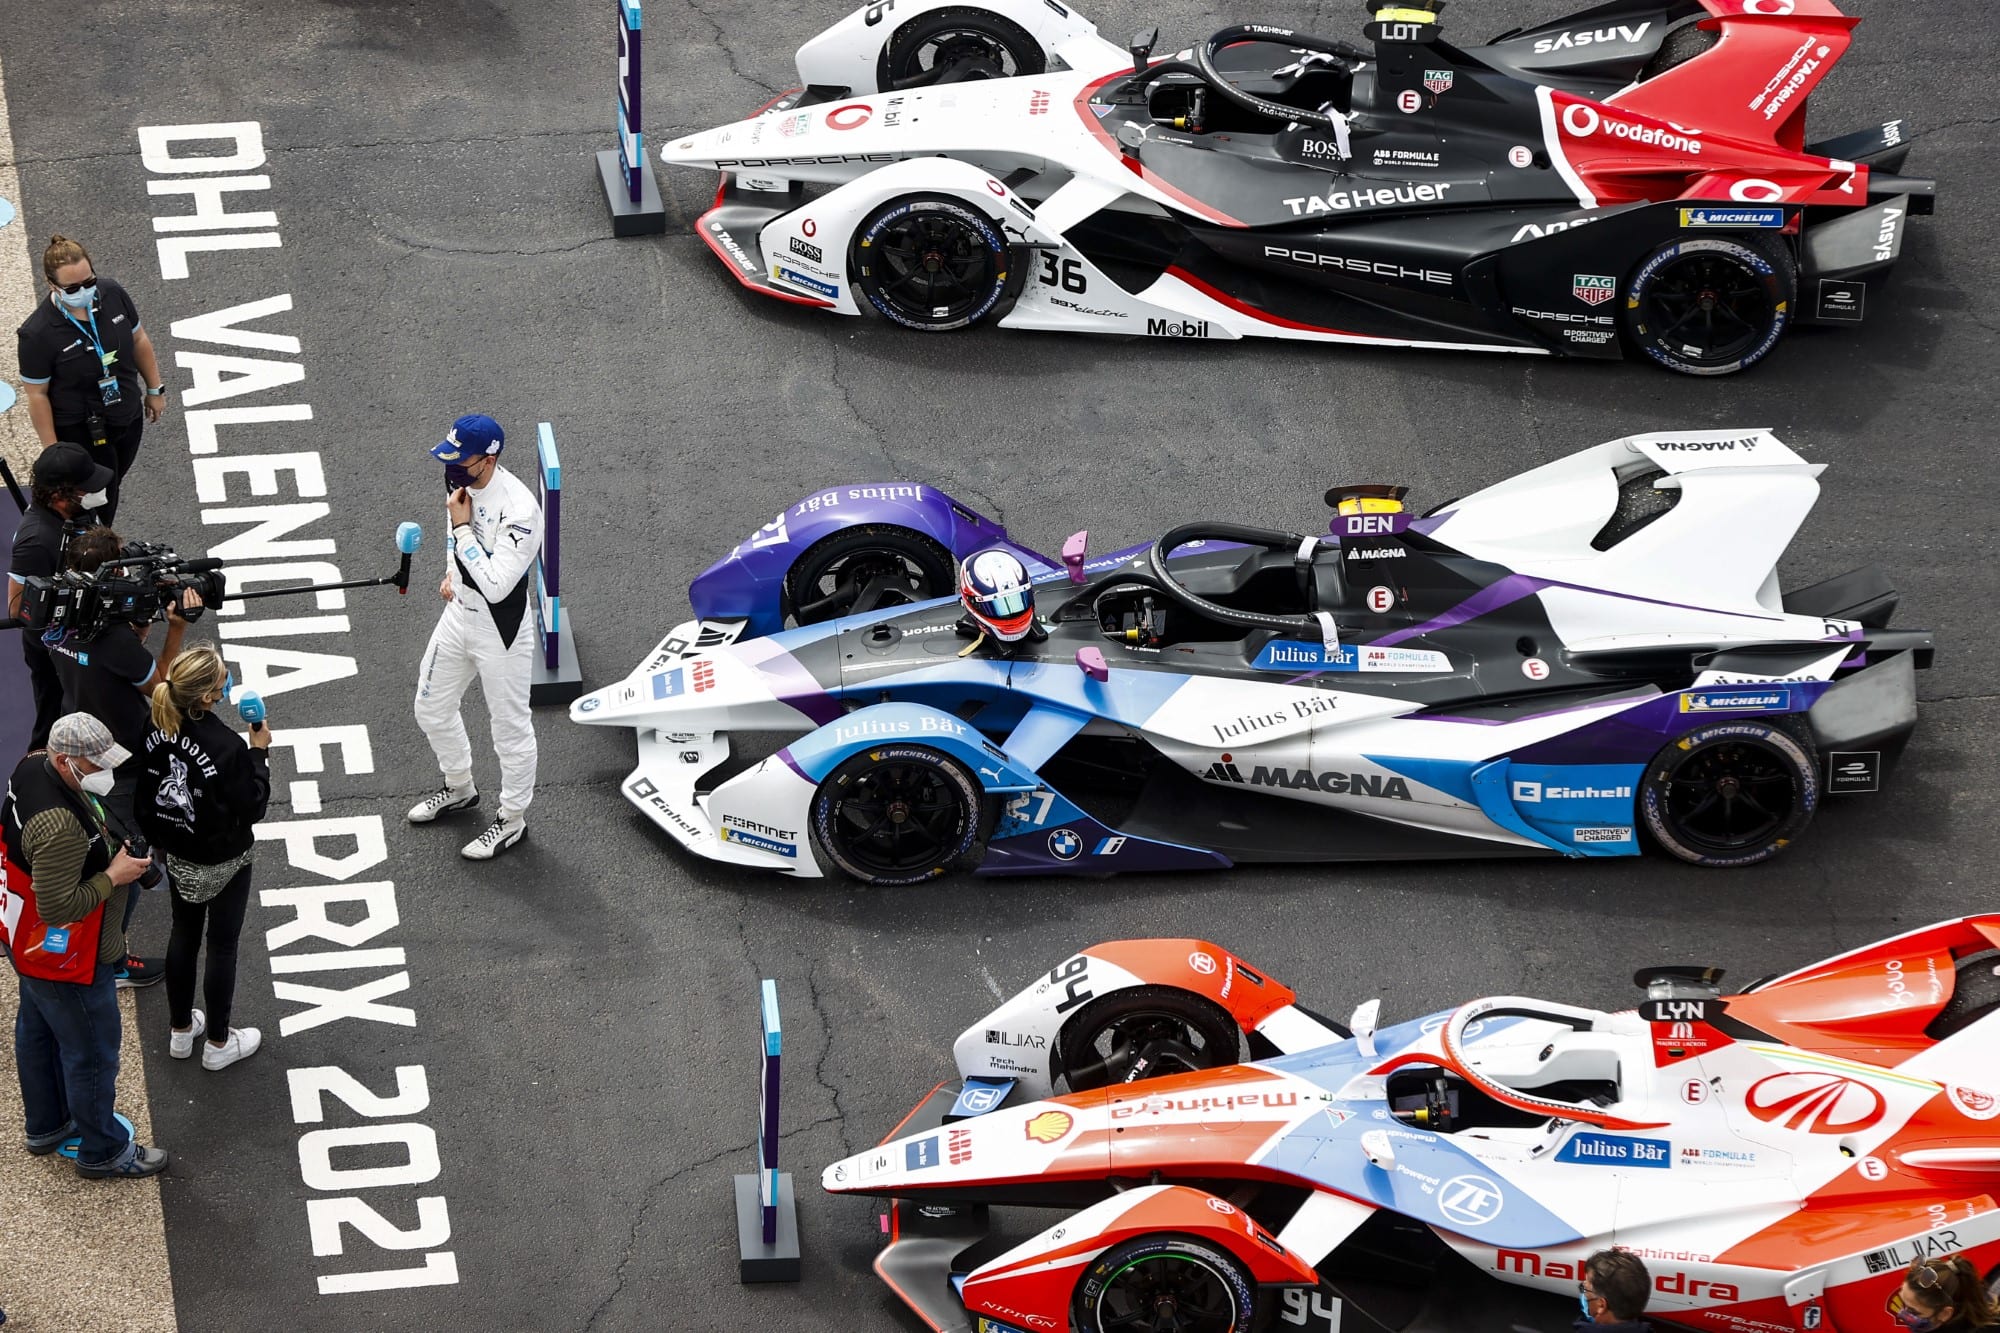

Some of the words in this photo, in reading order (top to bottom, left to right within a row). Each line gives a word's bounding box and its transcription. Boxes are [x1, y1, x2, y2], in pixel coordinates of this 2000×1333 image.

[1381, 23, 1422, 40] LOT
[1534, 22, 1651, 53] Ansys
[1427, 71, 1450, 80] TAG
[1748, 36, 1817, 111] PORSCHE
[1425, 80, 1451, 92] HEUER
[1029, 89, 1050, 115] ABB
[1403, 93, 1415, 109] E
[884, 97, 904, 127] Mobil
[1602, 119, 1701, 154] vodafone
[714, 153, 893, 170] PORSCHE
[1373, 150, 1390, 158] ABB
[1393, 151, 1432, 161] FORMULA
[1434, 153, 1439, 161] E
[1516, 150, 1525, 163] E
[138, 121, 282, 280] DHL
[870, 207, 907, 235] MICHELIN
[1709, 212, 1774, 223] MICHELIN
[1872, 208, 1903, 261] Ansys
[791, 238, 821, 258] BOSS
[773, 252, 840, 279] PORSCHE
[1039, 250, 1086, 294] 36
[1265, 245, 1452, 285] PORSCHE
[1634, 248, 1675, 290] MICHELIN
[791, 275, 833, 294] MICHELIN
[1577, 276, 1612, 288] TAG
[1575, 287, 1612, 304] HEUER
[1512, 307, 1614, 325] PORSCHE
[1147, 318, 1209, 338] Mobil
[1571, 330, 1615, 339] POSITIVELY
[1571, 336, 1607, 344] CHARGED
[1656, 441, 1735, 451] MAGNA
[170, 293, 357, 706] VALENCIA
[849, 485, 923, 502] Julius
[795, 492, 839, 517] Bär
[1347, 516, 1394, 535] DEN
[1361, 548, 1407, 560] MAGNA
[1374, 590, 1387, 609] E
[1269, 645, 1318, 664] Julius
[1368, 652, 1385, 660] ABB
[1388, 652, 1428, 662] FORMULA
[1430, 654, 1436, 662] E
[692, 660, 715, 693] ABB
[1528, 661, 1542, 677] E
[1710, 697, 1780, 706] MICHELIN
[1212, 711, 1287, 744] Julius
[1291, 696, 1338, 719] Bär
[835, 720, 911, 745] Julius
[920, 716, 967, 736] Bär
[1702, 726, 1766, 739] MICHELIN
[889, 750, 939, 763] MICHELIN
[1250, 766, 1413, 800] MAGNA
[1546, 786, 1631, 798] Einhell
[650, 796, 701, 838] Einhell
[1006, 790, 1055, 826] 27
[722, 814, 798, 841] FORTINET
[1584, 828, 1630, 836] POSITIVELY
[742, 837, 790, 854] MICHELIN
[239, 724, 417, 1037] E-PRIX
[1050, 956, 1093, 1014] 94
[1656, 1002, 1704, 1020] LYN
[990, 1056, 1015, 1065] Tech
[1688, 1082, 1700, 1102] E
[948, 1129, 973, 1166] ABB
[1574, 1138, 1627, 1158] Julius
[1632, 1142, 1667, 1161] Bär
[1681, 1148, 1700, 1157] ABB
[1702, 1149, 1748, 1161] FORMULA
[1749, 1153, 1755, 1162] E
[1397, 1164, 1440, 1186] Powered
[1865, 1161, 1878, 1176] E
[286, 1064, 459, 1295] 2021
[1421, 1184, 1434, 1195] by
[1441, 1178, 1499, 1222] ZF
[981, 1300, 1057, 1328] NIPPON
[1281, 1288, 1343, 1333] 94
